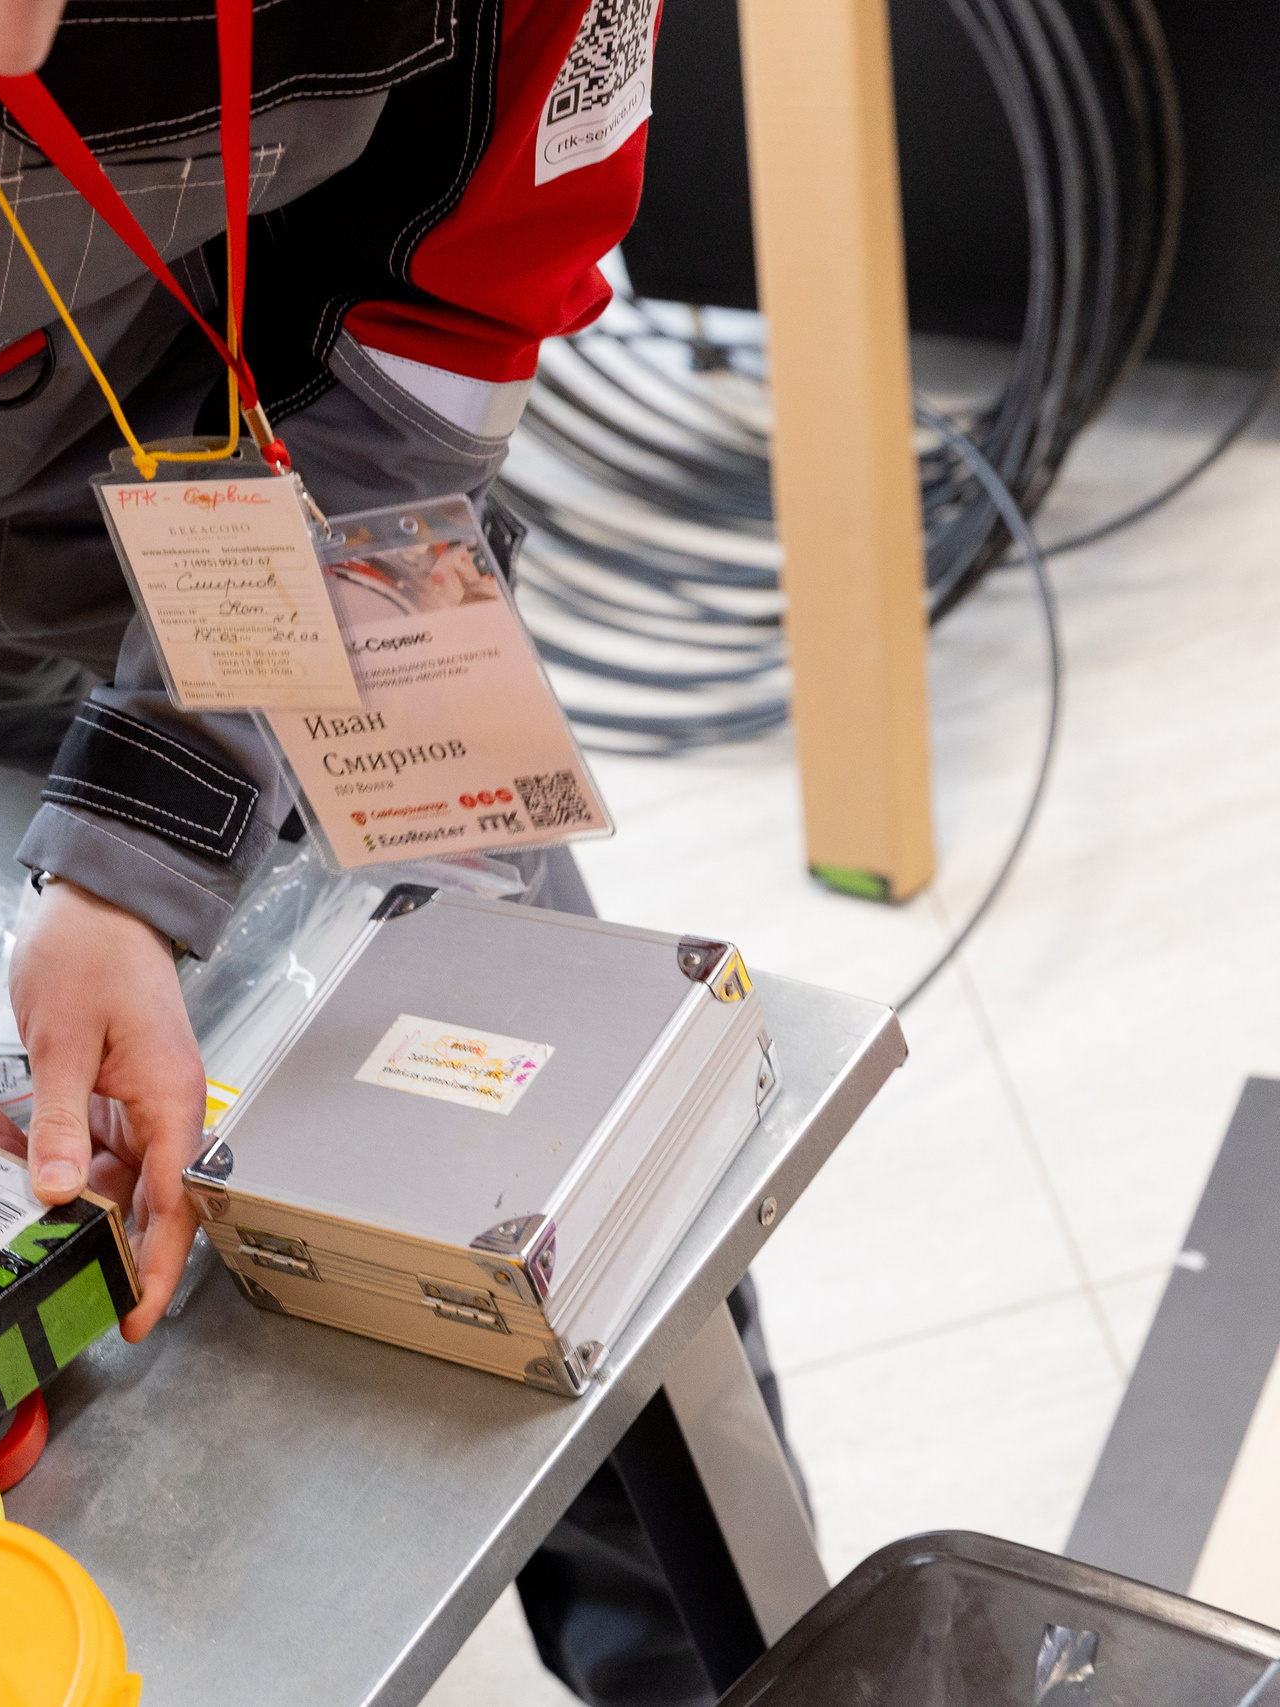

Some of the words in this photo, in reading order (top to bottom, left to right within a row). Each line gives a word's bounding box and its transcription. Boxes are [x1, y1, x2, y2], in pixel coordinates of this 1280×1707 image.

[556, 93, 638, 154] rtk-service.ru
[176, 571, 277, 598] Смирнов
[303, 711, 387, 740] Иван
[322, 738, 467, 778] Смирнов
